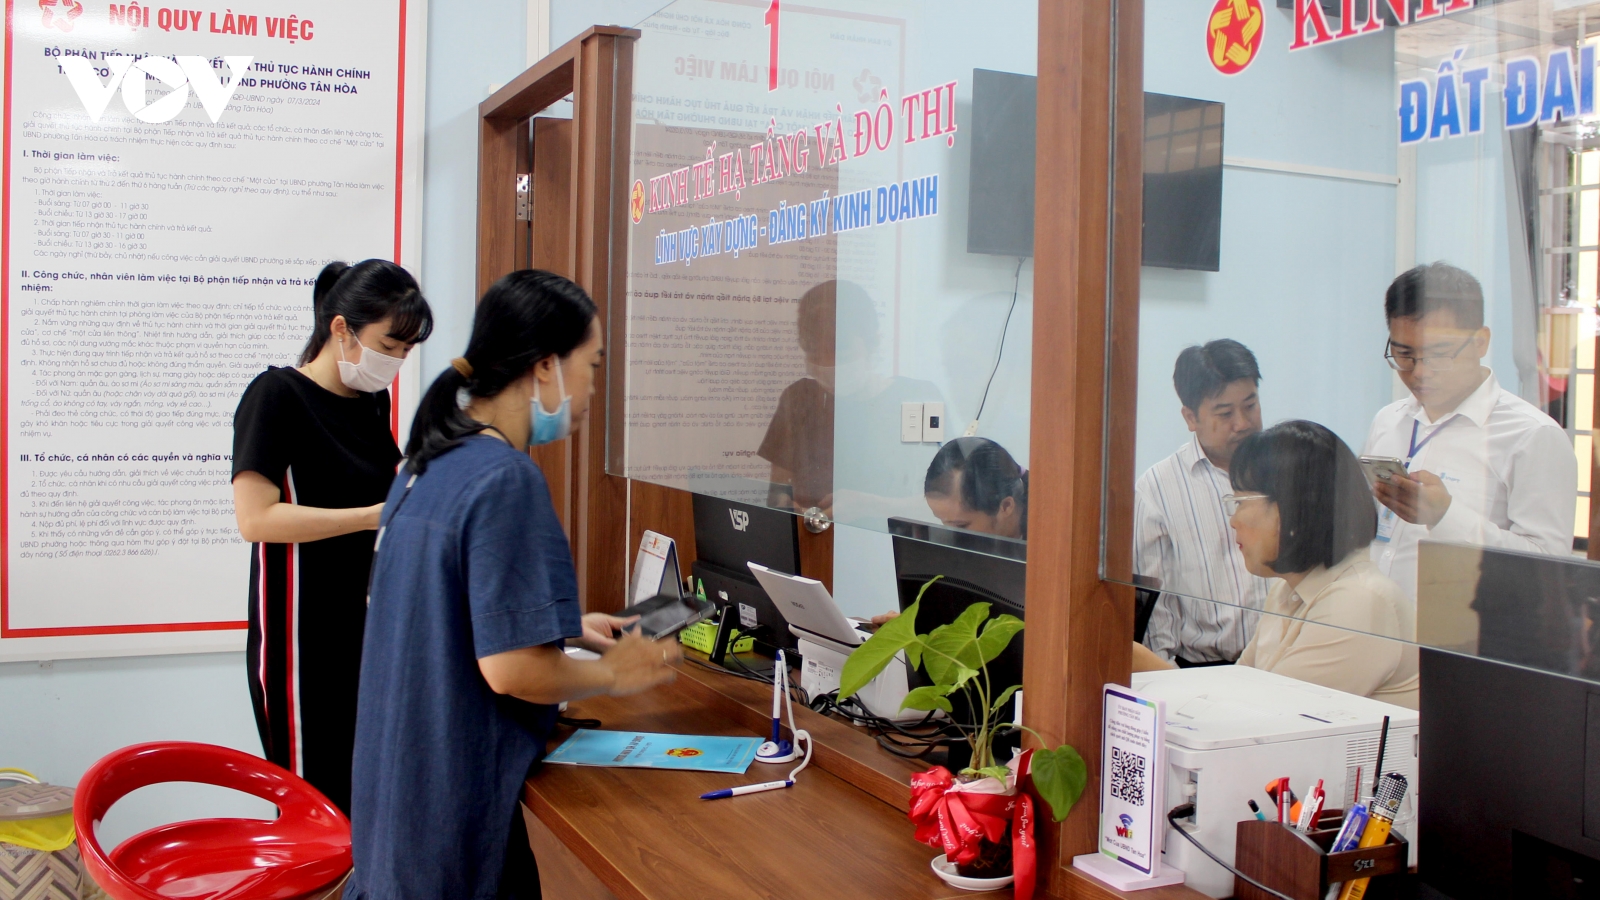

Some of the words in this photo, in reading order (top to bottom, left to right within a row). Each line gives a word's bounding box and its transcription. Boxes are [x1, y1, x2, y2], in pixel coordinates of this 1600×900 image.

[109, 1, 150, 32] NỘI
[158, 8, 202, 32] QUY
[210, 9, 258, 36] LÀM
[265, 14, 314, 44] VIỆC
[764, 0, 780, 92] 1
[255, 61, 274, 72] THỦ
[278, 64, 299, 76] TỤC
[302, 63, 333, 77] HÀNH
[336, 66, 370, 79] CHÍNH
[260, 78, 307, 91] PHƯỜNG
[311, 81, 330, 92] TÂN
[334, 83, 358, 94] HÒA
[1398, 44, 1491, 144] ĐẤT
[1503, 44, 1596, 130] ĐAI
[32, 150, 50, 158] Thời
[53, 152, 74, 160] gian
[77, 152, 94, 160] làm
[98, 153, 119, 162] việc:
[649, 166, 689, 213] KINH
[692, 142, 714, 201] TẾ
[719, 149, 746, 201] HẠ
[750, 116, 809, 186] TẦNG
[814, 102, 848, 168] VÀ
[853, 86, 894, 158] ĐÔ
[901, 80, 958, 148] THỊ
[655, 228, 678, 265] LĨNH
[679, 224, 699, 266] VỰC
[700, 217, 723, 258] XÂY
[725, 214, 758, 258] DỰNG
[769, 200, 806, 244] ĐĂNG
[810, 190, 830, 238] KÝ
[832, 188, 872, 234] KINH
[876, 174, 939, 225] DOANH
[21, 284, 52, 292] nhiệm:
[33, 270, 58, 280] Công
[61, 271, 87, 279] chức,
[138, 273, 154, 281] làm
[158, 274, 176, 283] việc
[179, 275, 190, 283] tại
[193, 275, 204, 283] Bộ
[207, 276, 229, 284] phận
[232, 275, 249, 284] tiếp
[252, 277, 273, 285] nhận
[289, 277, 300, 285] trả
[34, 452, 45, 461] Tổ
[76, 453, 88, 461] cá
[117, 453, 128, 461] có
[152, 452, 179, 461] quyền
[196, 454, 220, 462] nghĩa
[729, 508, 749, 532] VSP
